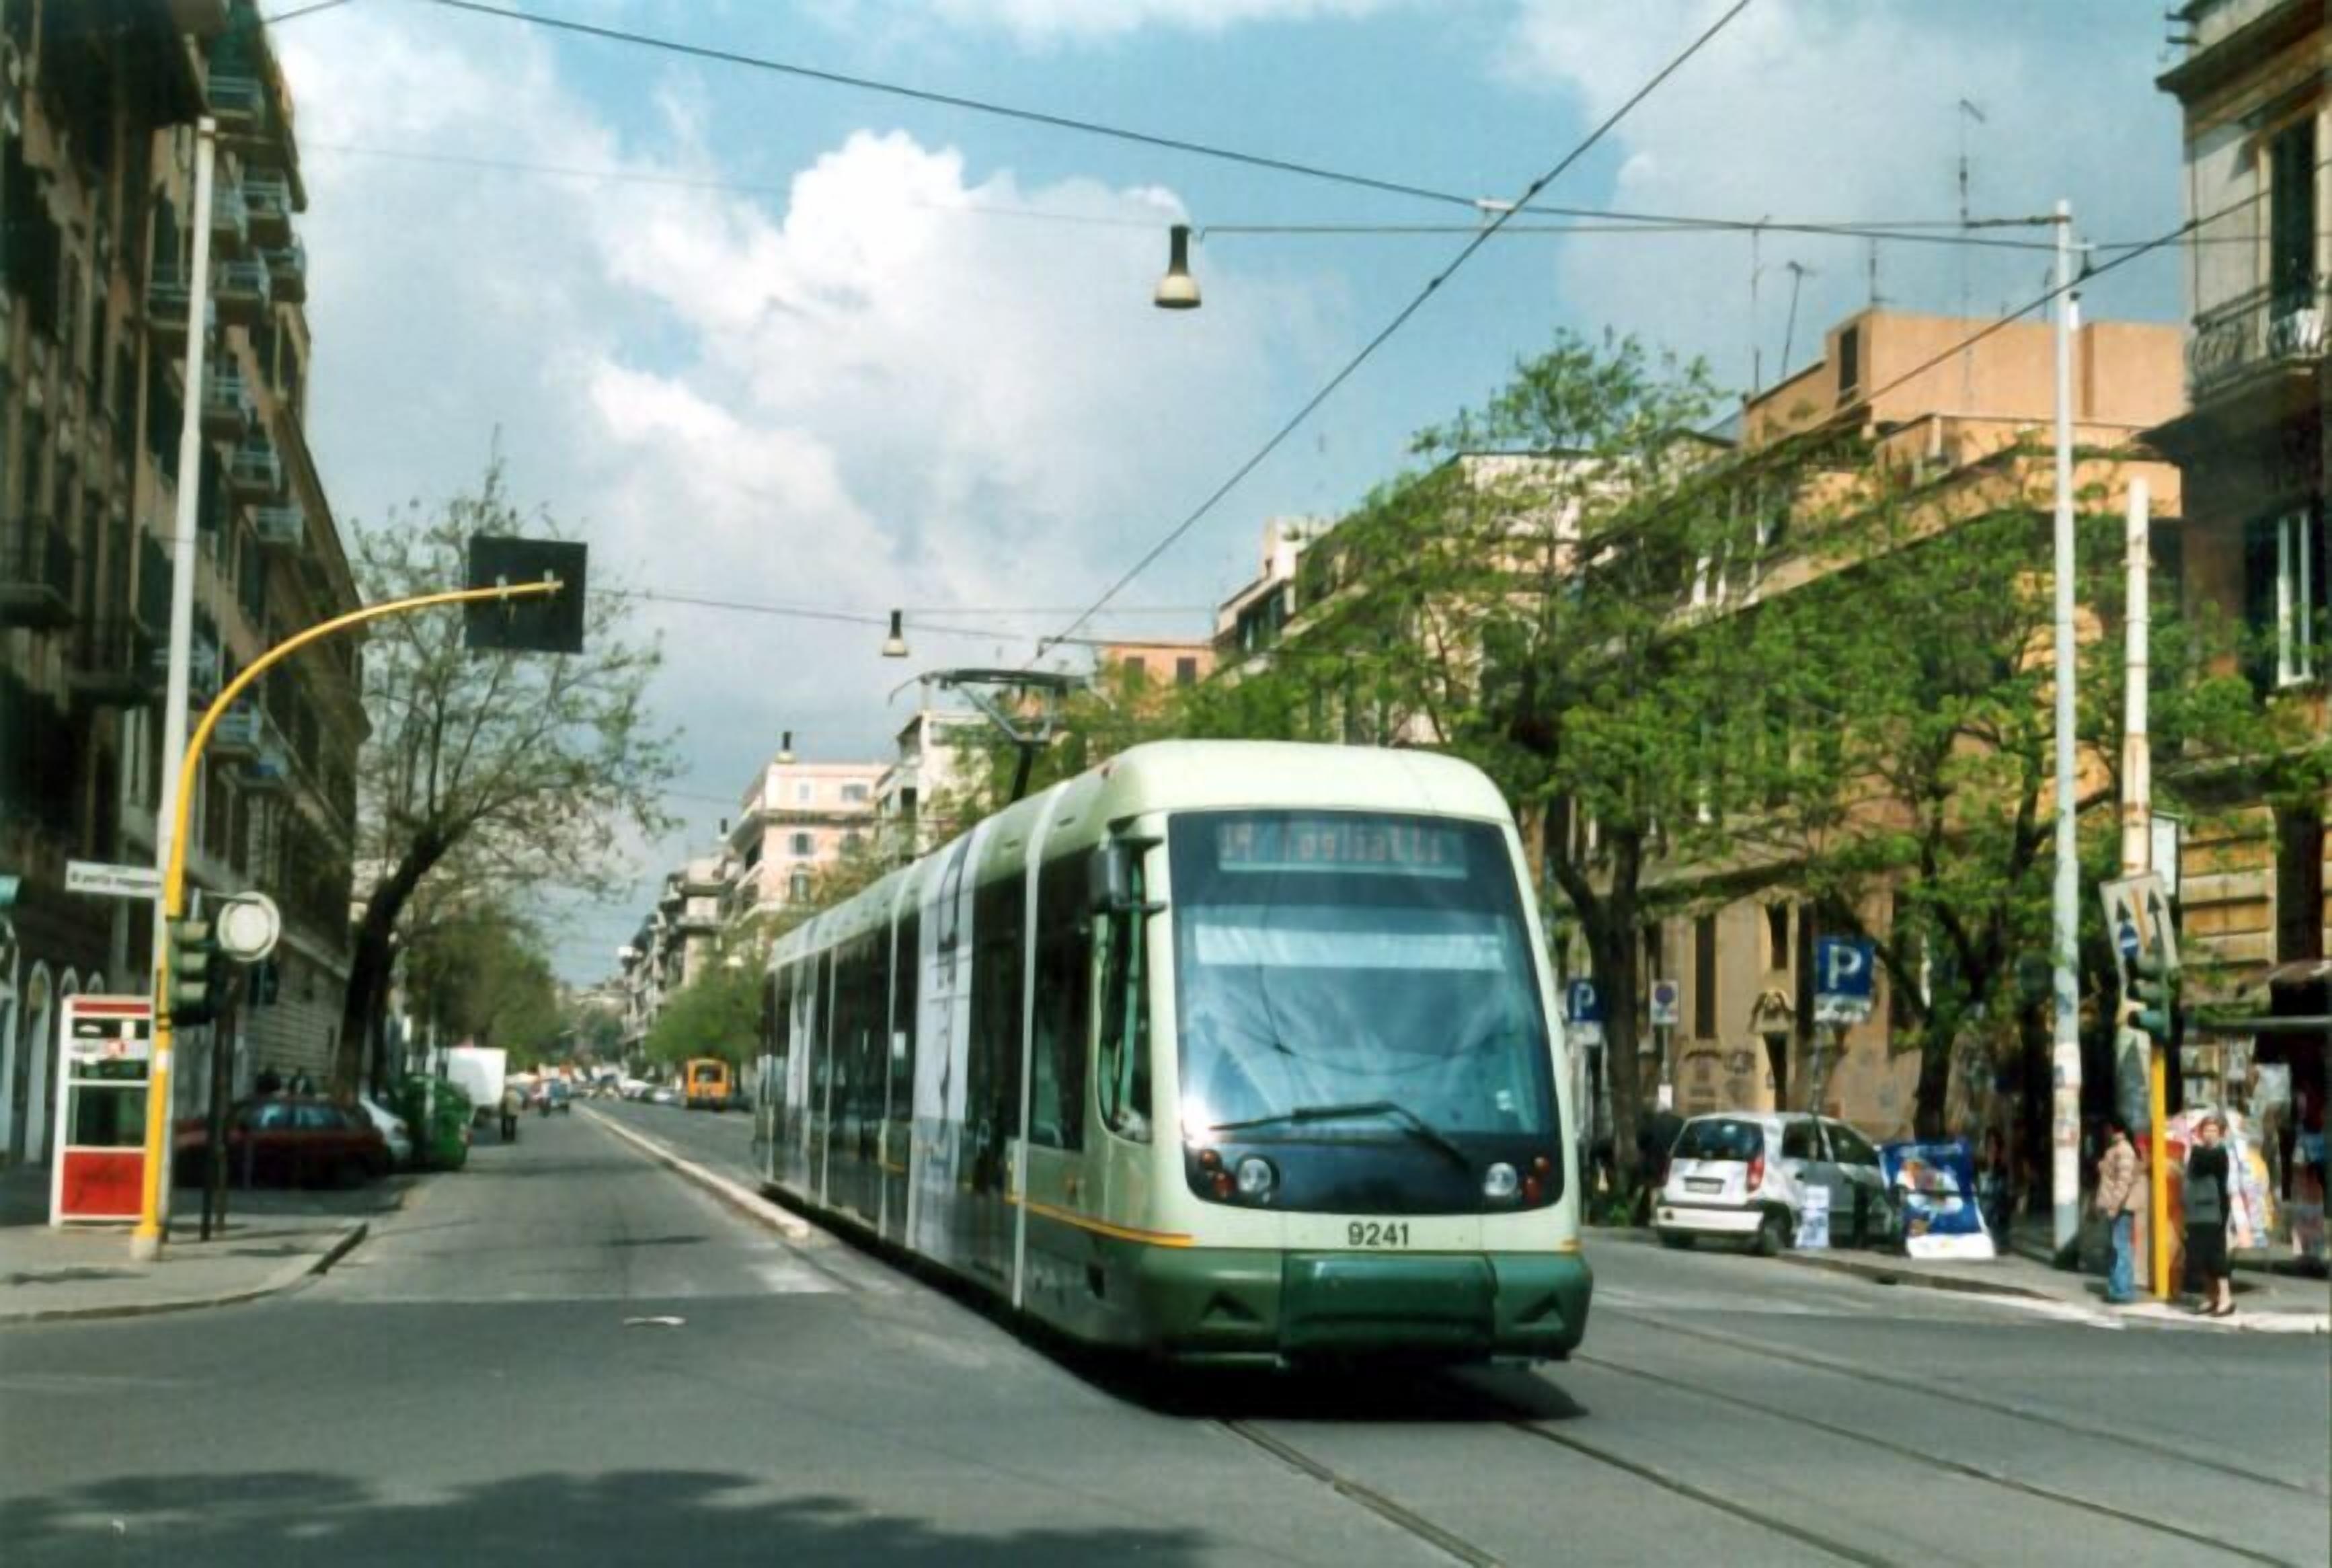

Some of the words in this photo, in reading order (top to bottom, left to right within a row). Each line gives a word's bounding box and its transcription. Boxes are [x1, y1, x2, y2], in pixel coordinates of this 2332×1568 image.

[1828, 943, 1862, 989] P
[1574, 982, 1596, 1018] P
[1348, 1221, 1409, 1245] 9241
